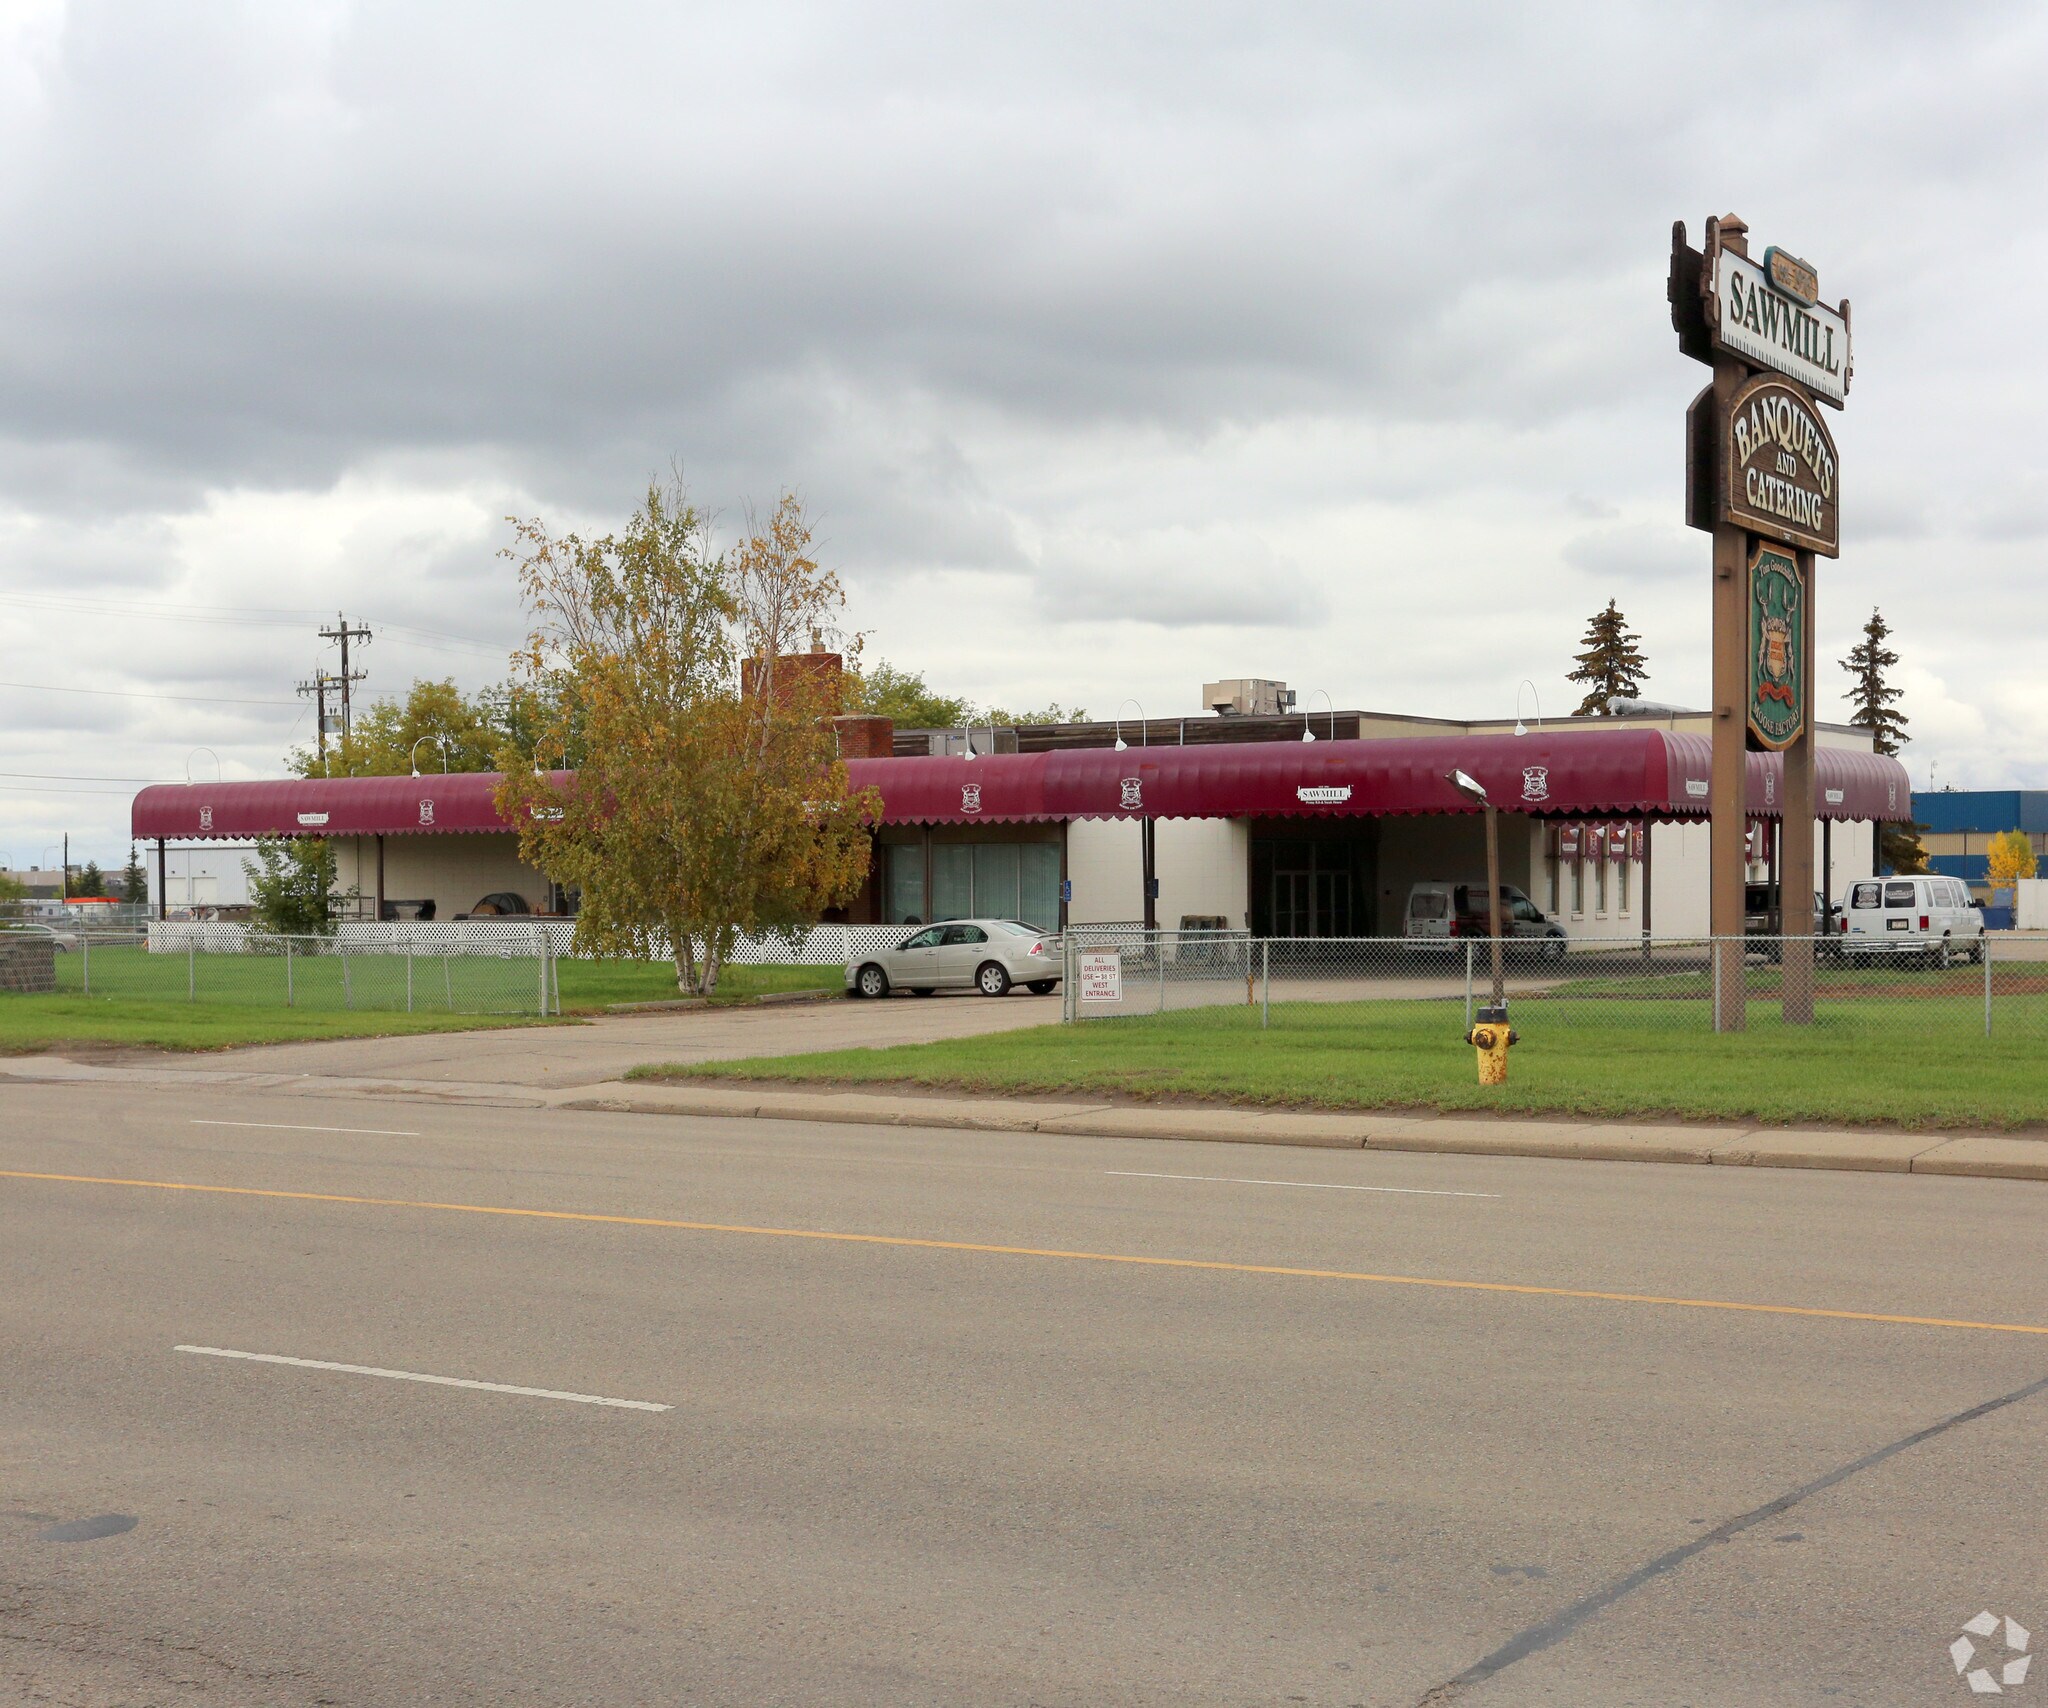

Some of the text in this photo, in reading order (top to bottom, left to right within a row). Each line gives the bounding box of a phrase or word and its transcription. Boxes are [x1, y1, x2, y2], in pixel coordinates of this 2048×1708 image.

[1730, 270, 1839, 376] SAWMILL
[1735, 396, 1833, 499] BANQUETS
[1775, 452, 1797, 478] AND
[1746, 467, 1823, 531] CATERING
[1752, 701, 1799, 735] MOOSE FACTORY
[1302, 790, 1345, 798] SAWMILL
